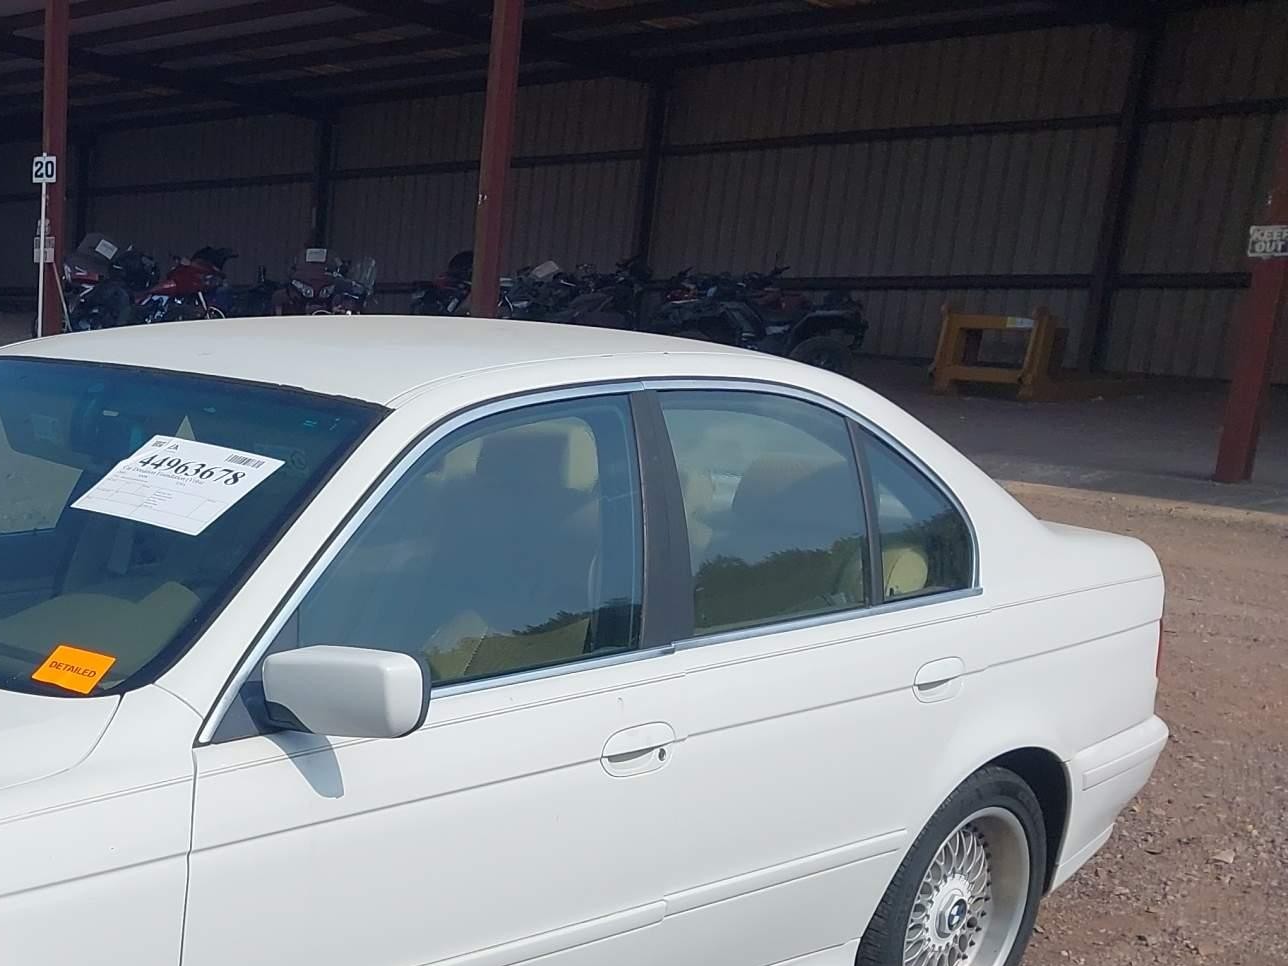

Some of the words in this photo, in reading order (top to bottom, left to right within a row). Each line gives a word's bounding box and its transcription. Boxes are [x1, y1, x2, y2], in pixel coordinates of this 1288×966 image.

[34, 160, 55, 179] 20
[1255, 240, 1286, 252] OUT
[138, 454, 246, 486] 44963678
[48, 660, 97, 678] DETAILED
